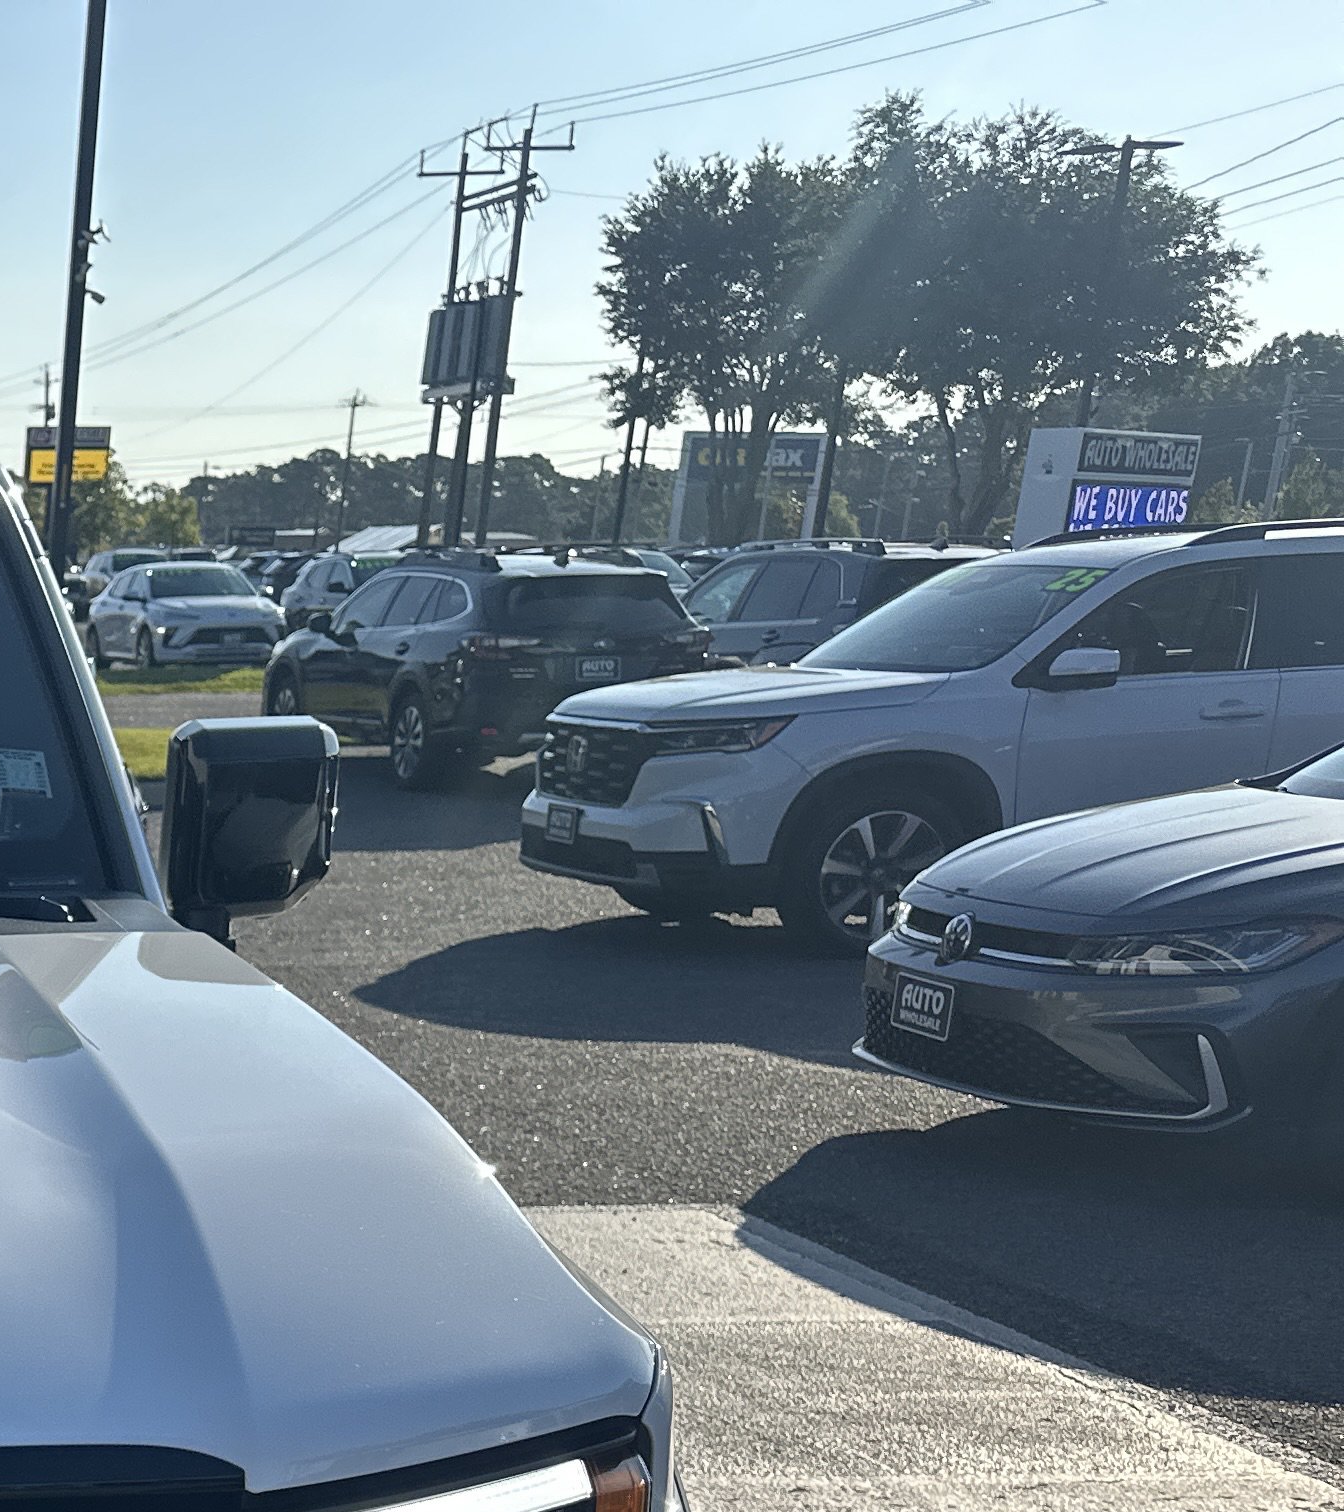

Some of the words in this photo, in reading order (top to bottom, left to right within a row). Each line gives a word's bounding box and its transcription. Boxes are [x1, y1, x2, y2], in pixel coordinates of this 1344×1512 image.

[1084, 439, 1123, 468] AUTO
[1125, 440, 1196, 471] WHOLESALE
[1073, 486, 1101, 521] WE
[1103, 488, 1143, 522] BUY
[1145, 489, 1189, 523] CARS
[1044, 568, 1110, 593] 25
[902, 983, 945, 1015] AUTO
